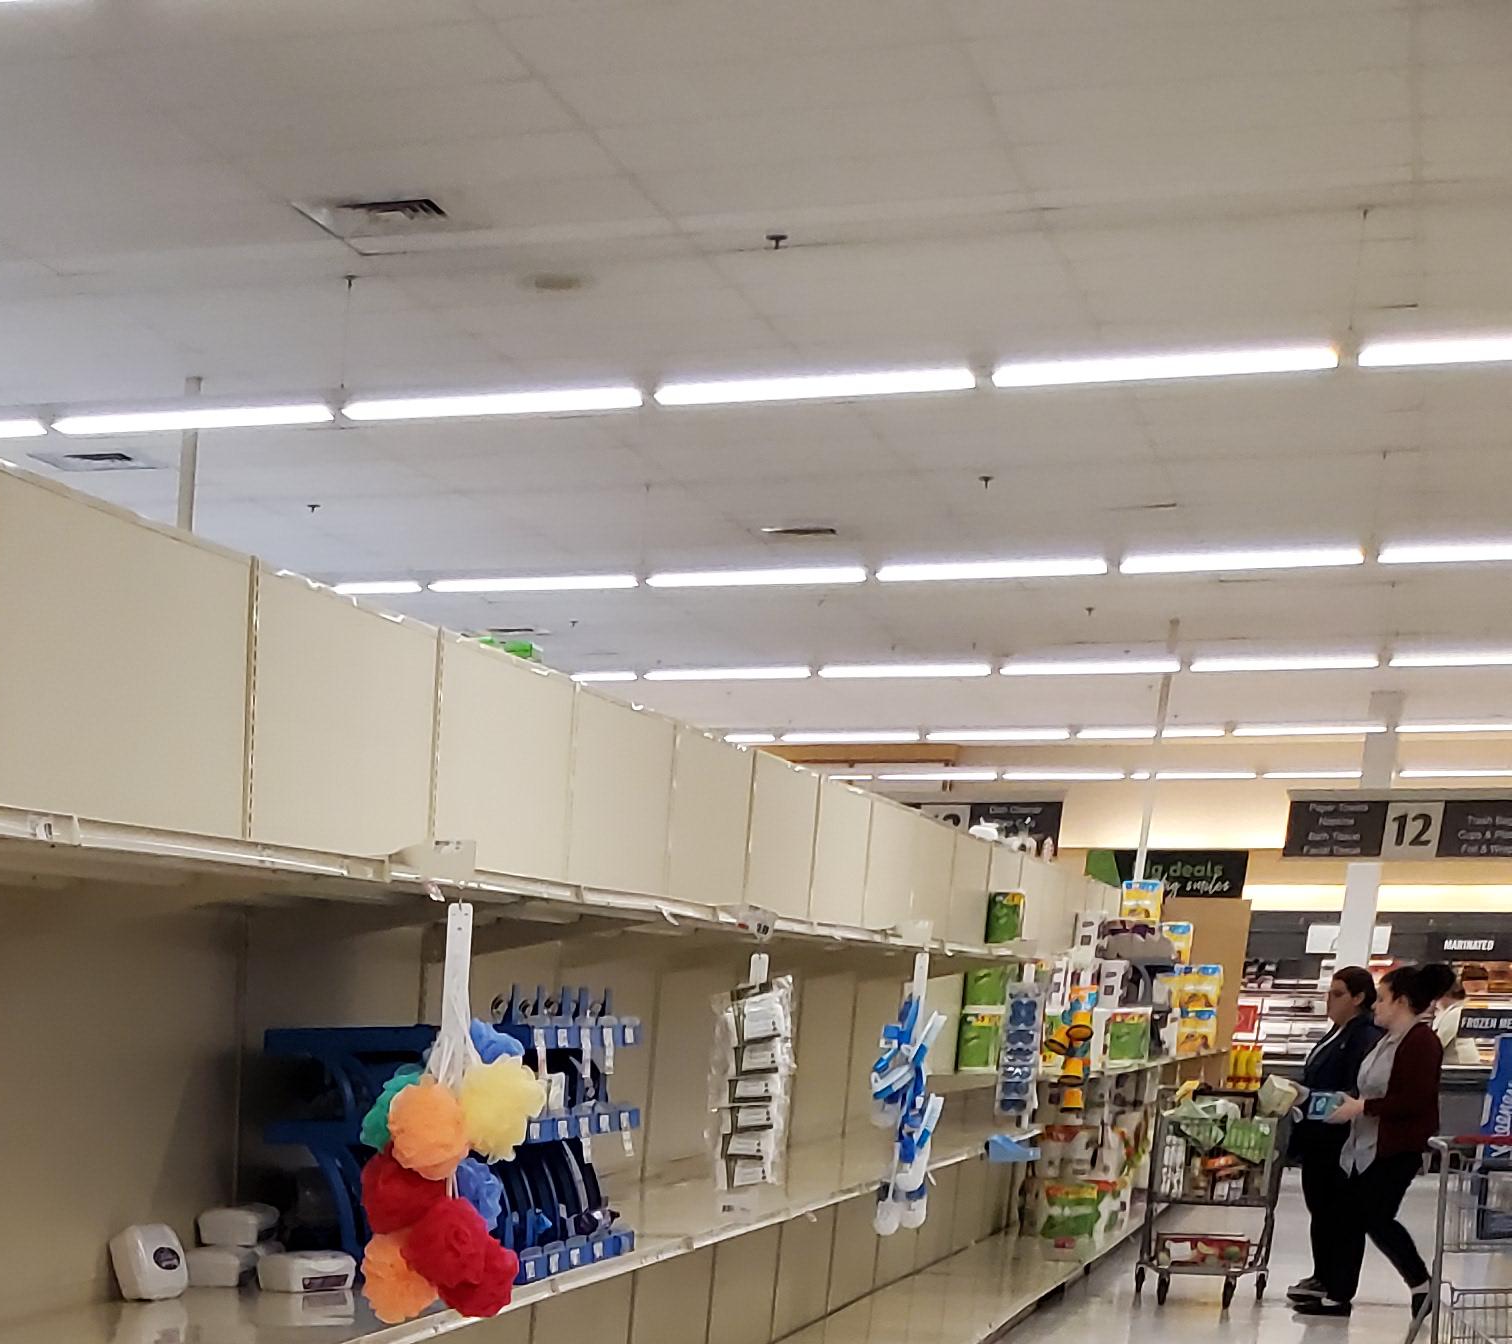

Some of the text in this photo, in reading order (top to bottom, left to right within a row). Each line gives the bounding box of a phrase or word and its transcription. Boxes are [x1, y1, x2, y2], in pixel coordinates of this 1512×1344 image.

[1392, 813, 1432, 846] 12
[1169, 860, 1224, 877] deals
[1444, 939, 1495, 951] MARINATED
[1460, 1016, 1497, 1029] FROZEN
